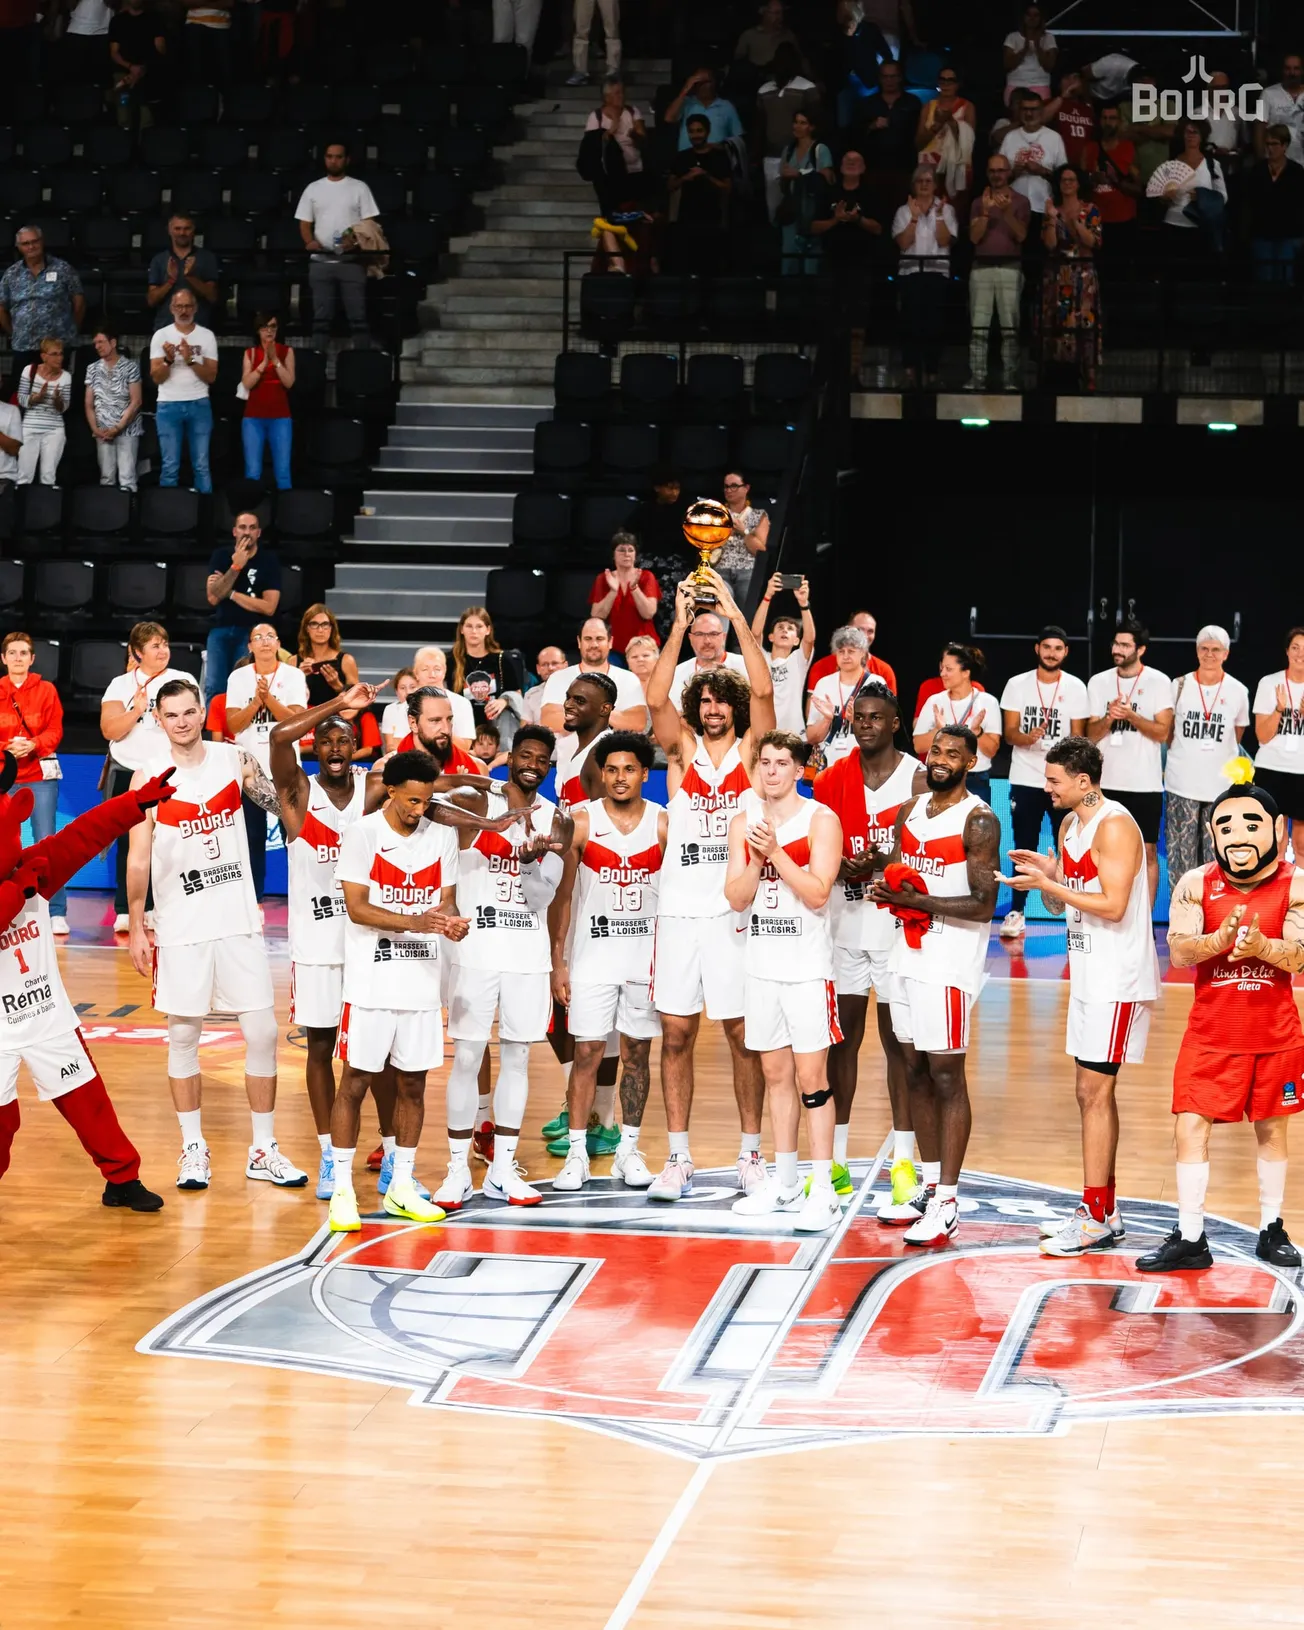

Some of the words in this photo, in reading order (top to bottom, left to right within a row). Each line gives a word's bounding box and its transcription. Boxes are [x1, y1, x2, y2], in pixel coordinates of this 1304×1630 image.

[1070, 125, 1085, 137] 10
[1187, 711, 1200, 720] AIN
[1202, 712, 1222, 723] STAR
[1183, 721, 1225, 742] GAME
[690, 791, 738, 811] BOURG
[178, 807, 235, 838] BOURG
[699, 812, 727, 837] 16
[202, 836, 221, 860] 3
[489, 854, 520, 874] BOU
[681, 854, 699, 866] 55
[203, 863, 240, 877] BRASSERIE
[210, 870, 242, 885] LOISIRS
[600, 866, 651, 885] BOURG
[183, 879, 204, 896] 55
[496, 876, 527, 904] 33
[764, 882, 778, 909] 5
[612, 886, 642, 911] 13
[313, 906, 334, 921] 55
[477, 917, 496, 929] 55
[504, 919, 533, 928] LOISIRS
[617, 926, 648, 935] LOISIRS
[0, 920, 40, 951] OURG
[590, 926, 609, 938] 55
[394, 942, 428, 950] BRASSERIE
[14, 948, 30, 974] 1
[1237, 981, 1261, 991] dieta
[2, 984, 52, 1014] Réma
[61, 1062, 81, 1079] AIN
